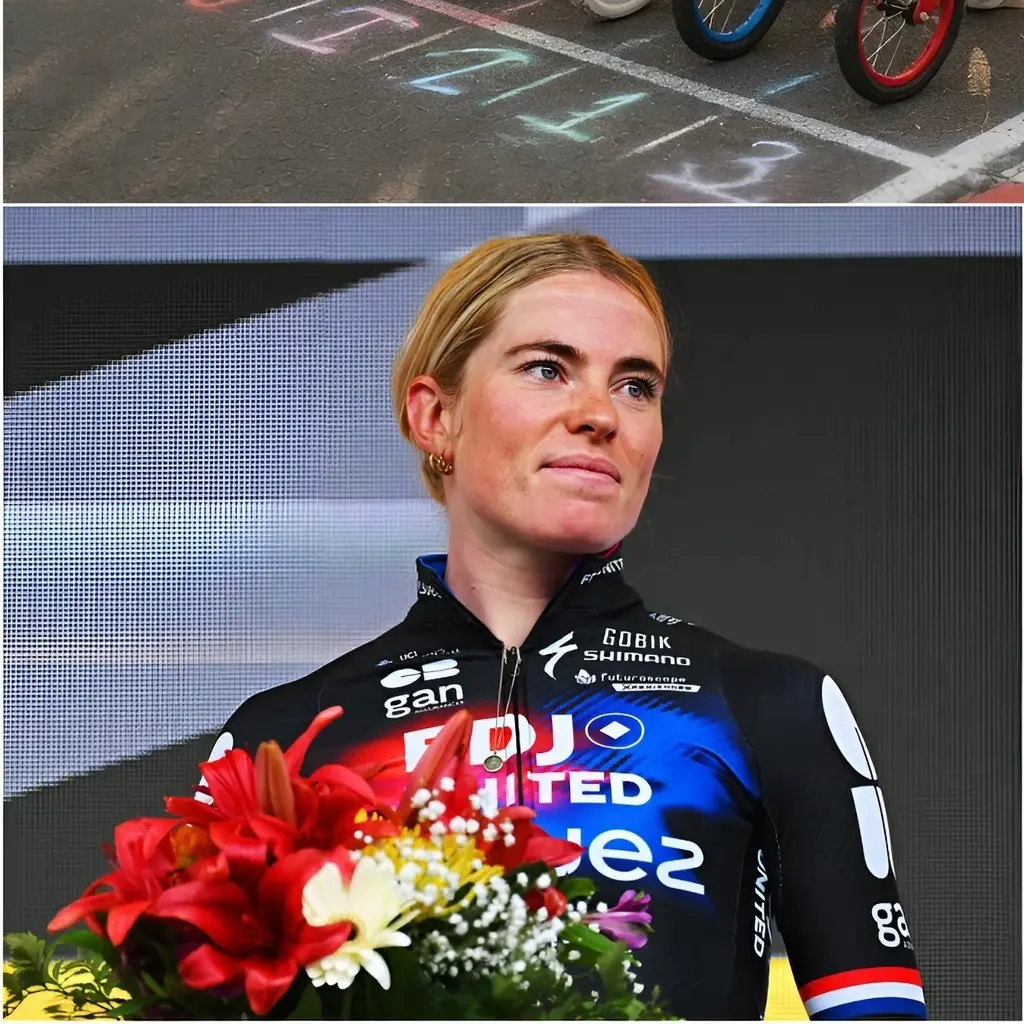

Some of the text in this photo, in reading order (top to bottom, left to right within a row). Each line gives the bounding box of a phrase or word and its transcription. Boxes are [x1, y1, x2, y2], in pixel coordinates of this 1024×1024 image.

[602, 627, 672, 650] GOBIK
[583, 650, 691, 666] SHIMANO
[384, 683, 464, 719] gan
